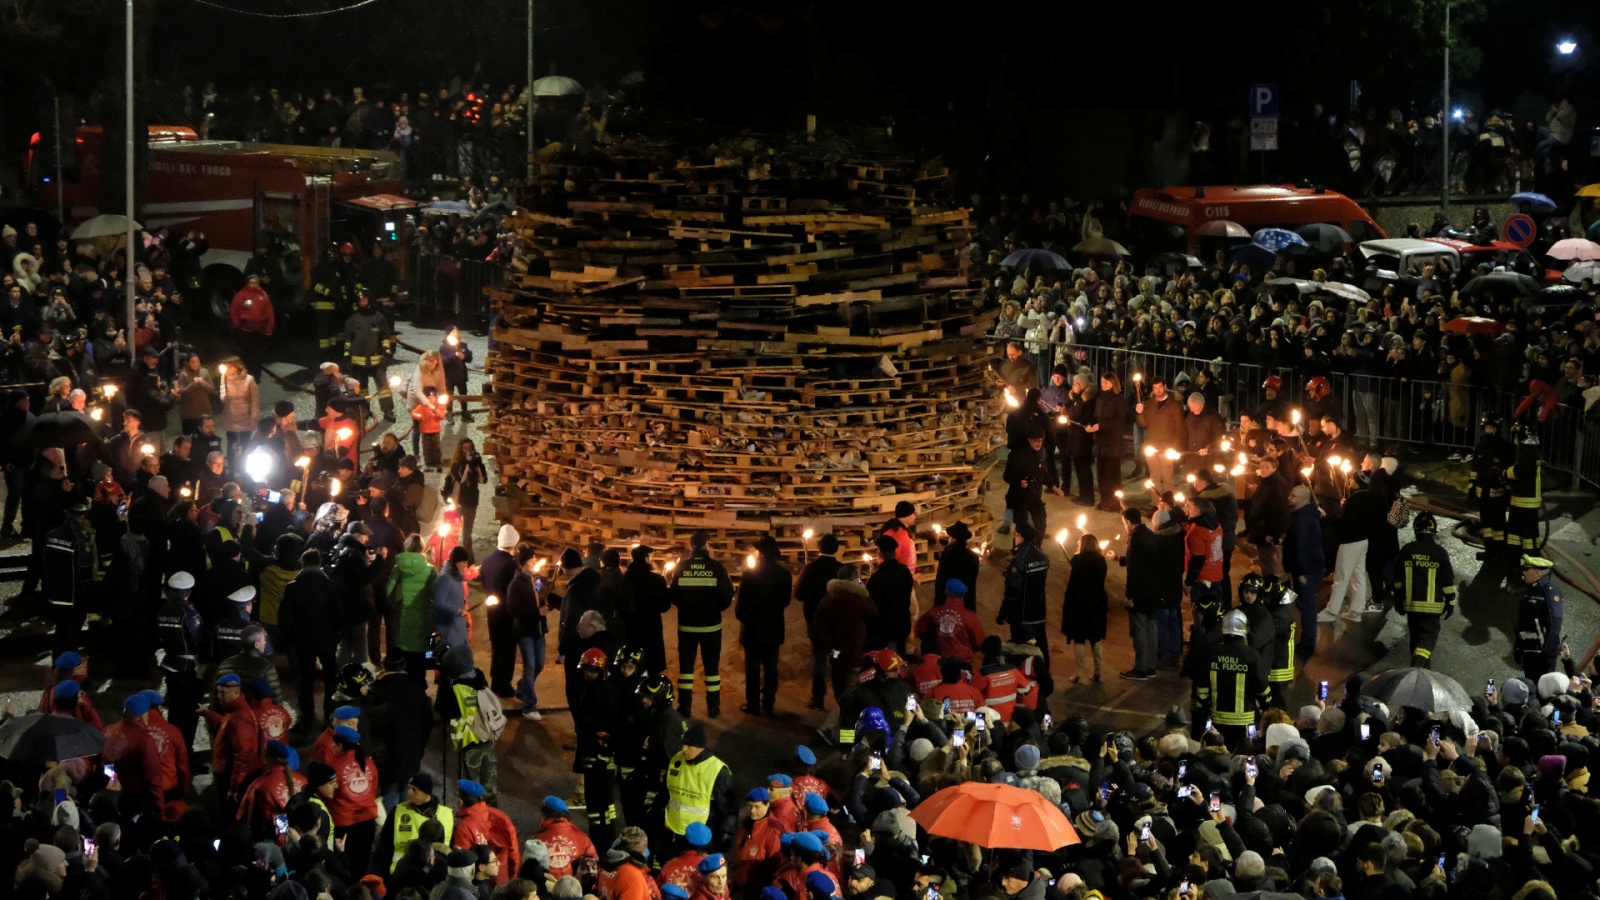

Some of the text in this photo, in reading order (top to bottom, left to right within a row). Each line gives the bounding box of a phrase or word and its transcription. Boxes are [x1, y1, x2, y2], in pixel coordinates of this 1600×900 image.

[1256, 87, 1272, 114] P
[180, 163, 197, 174] DEL
[201, 164, 231, 176] FUOCO
[1215, 206, 1230, 217] 115
[1411, 553, 1430, 561] VIGILI
[1415, 560, 1440, 568] FUOCO
[1217, 655, 1239, 664] VIGILI
[1210, 662, 1249, 672] EL FUOCO
